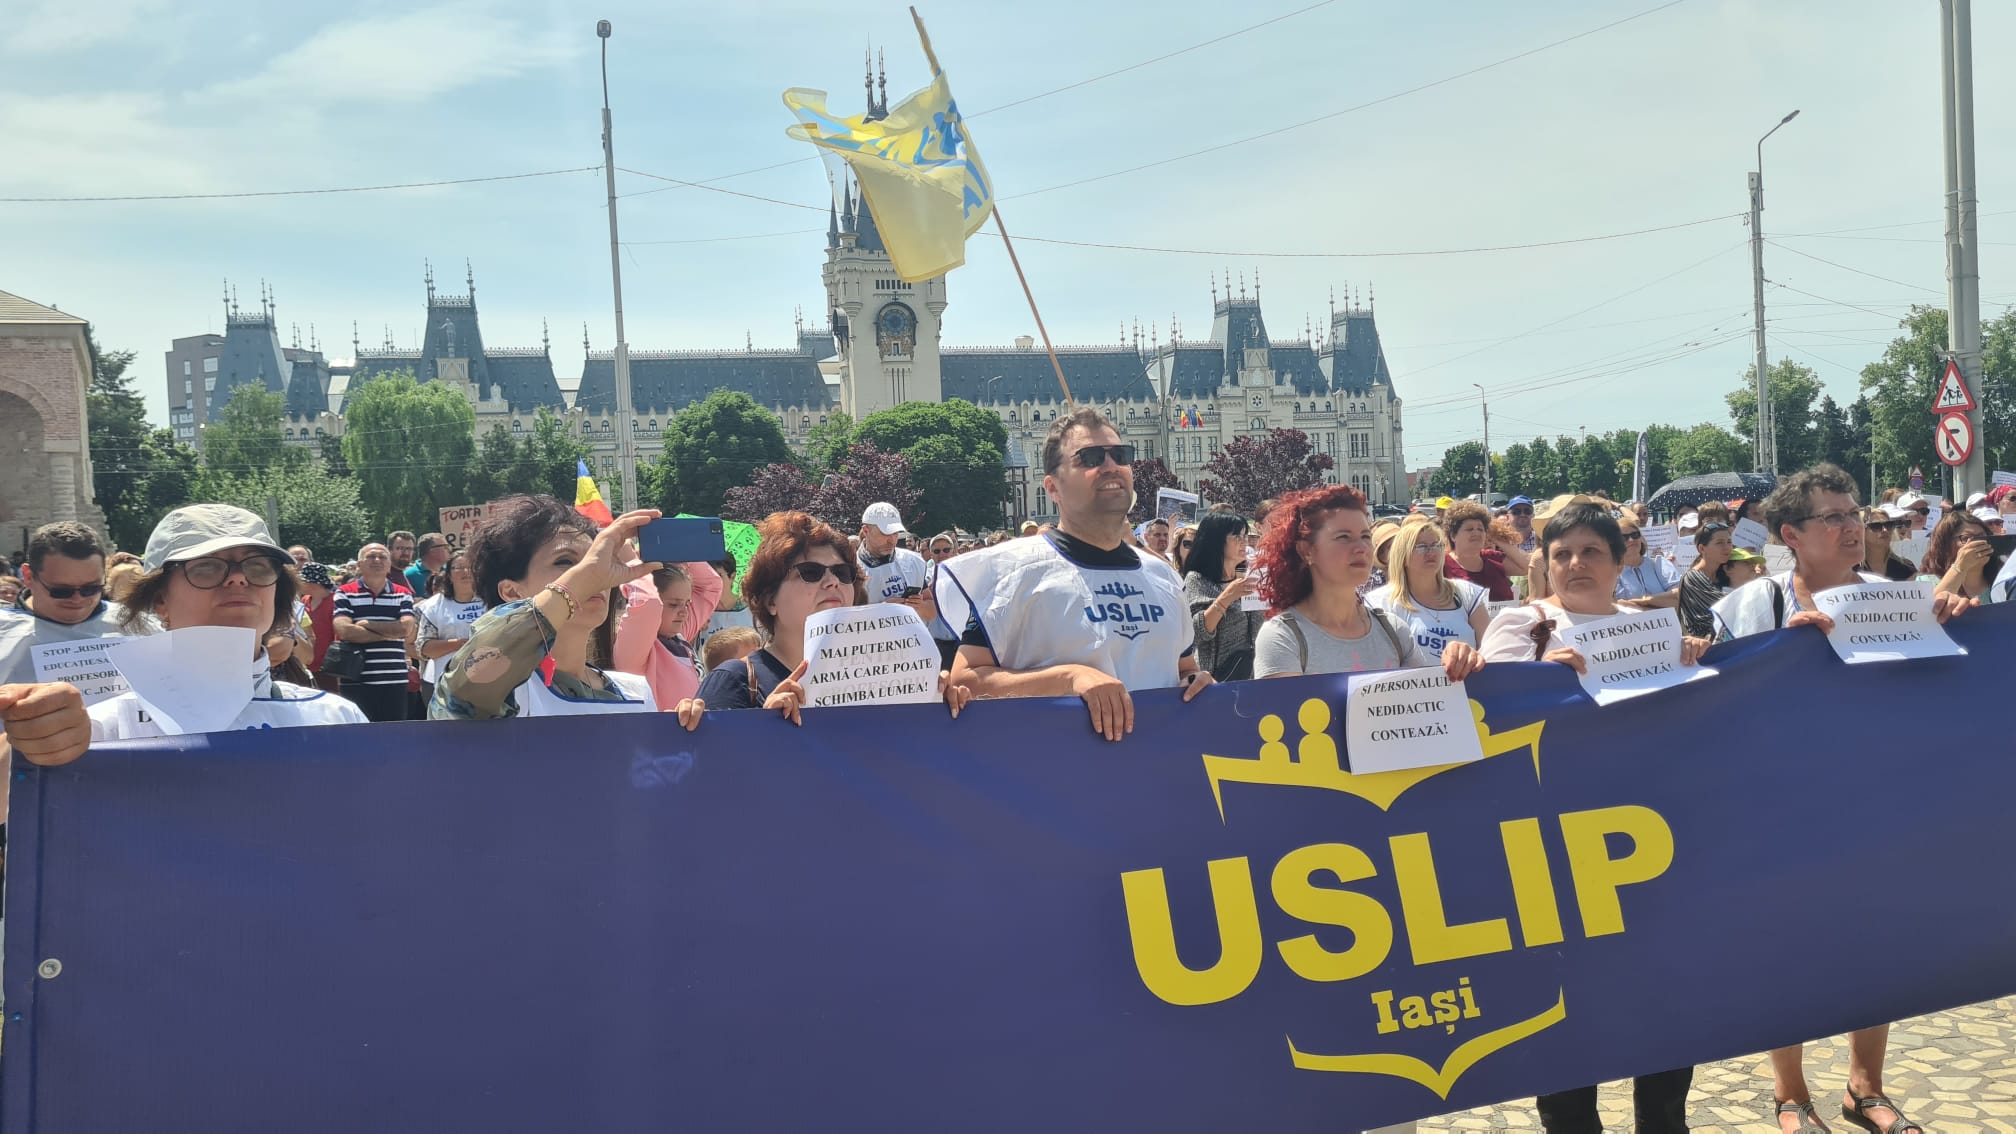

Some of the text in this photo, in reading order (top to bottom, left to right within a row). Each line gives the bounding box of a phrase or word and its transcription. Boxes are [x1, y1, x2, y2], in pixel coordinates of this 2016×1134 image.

[1843, 590, 1925, 602] PERSONALUL
[1084, 602, 1165, 623] USLIP
[1844, 611, 1918, 624] NEDIDACTIC
[810, 620, 876, 639] EDUCAȚIA
[878, 615, 904, 629] ESTE
[1590, 617, 1673, 641] PERSONALUL
[1849, 631, 1924, 645] CONTEAZĂ!
[43, 647, 71, 657] STOP
[820, 646, 847, 660] MAI
[851, 634, 921, 656] PUTERNICĂ
[1592, 640, 1671, 665] NEDIDACTIC
[810, 667, 850, 684] ARMĂ
[854, 664, 890, 679] CARE
[893, 657, 933, 674] POATE
[1601, 661, 1674, 684] CONTEAZĂ!
[815, 689, 876, 707] SCHIMBA
[878, 681, 928, 699] LUMEA!
[1373, 676, 1453, 694] PERSONALUL
[1367, 700, 1446, 718] NEDIDACTIC
[1371, 722, 1449, 742] CONTEAZĂ!
[1121, 805, 1674, 1006] USLIP
[1370, 977, 1481, 1035] Iași
